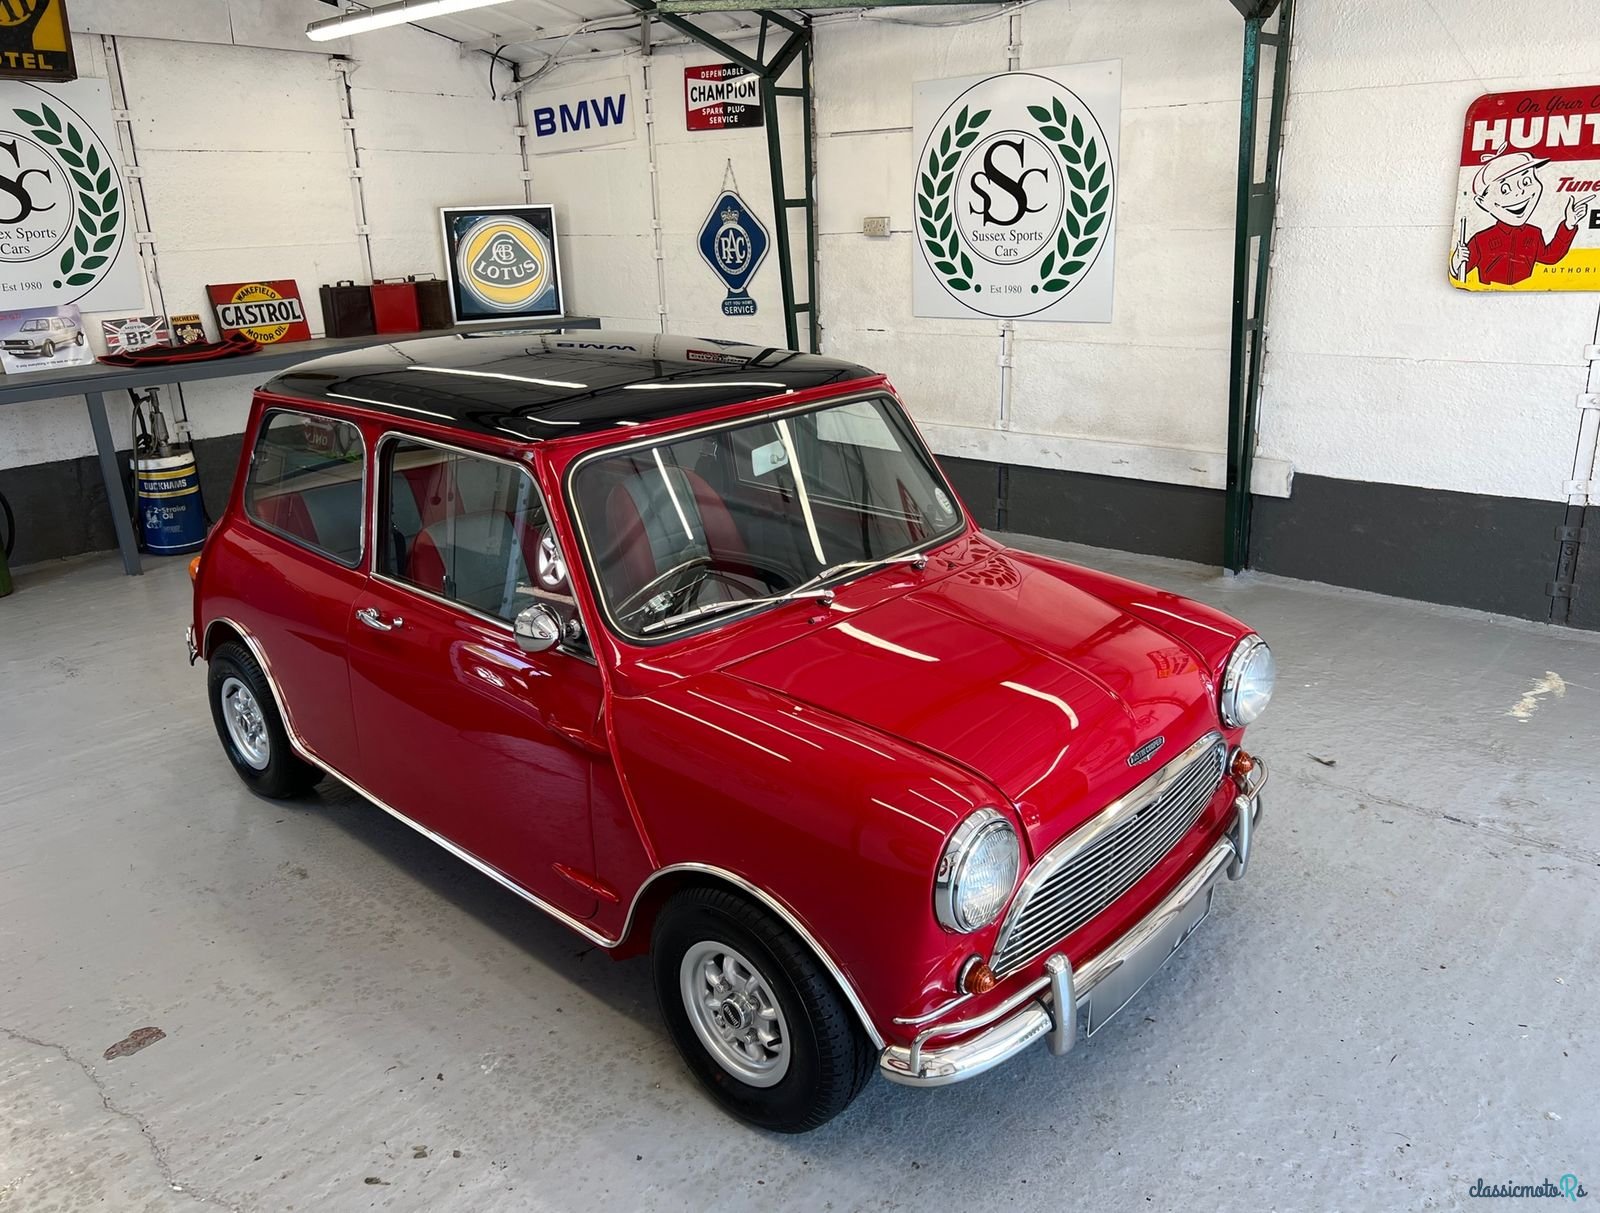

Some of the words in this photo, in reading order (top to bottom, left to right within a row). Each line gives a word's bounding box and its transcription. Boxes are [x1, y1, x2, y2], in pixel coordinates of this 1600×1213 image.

[0, 51, 53, 70] TEL
[701, 67, 744, 79] DEPENDABLE
[690, 80, 756, 103] CHAMPION
[702, 107, 724, 116] SPARK
[727, 105, 746, 114] PLUG
[1516, 97, 1541, 113] On
[1545, 95, 1583, 116] Your
[533, 93, 626, 137] BMW
[709, 115, 739, 125] SERVICE
[16, 227, 57, 242] Sports
[972, 230, 1006, 242] Sussex
[1009, 229, 1043, 244] Sports
[0, 243, 31, 255] Cars
[720, 229, 746, 264] RAC
[994, 244, 1019, 257] Cars
[476, 260, 536, 280] LOTUS
[2, 283, 17, 292] Est
[20, 281, 43, 291] 1980
[990, 284, 1002, 294] Est
[1004, 284, 1022, 294] 1980
[235, 287, 276, 302] WAKEFIELD
[221, 301, 302, 327] CASTROL
[724, 305, 755, 315] SERVICE
[124, 330, 152, 346] BP
[246, 328, 275, 341] MOTOR
[274, 325, 287, 337] OIL
[144, 479, 187, 490] DUCKHAMS
